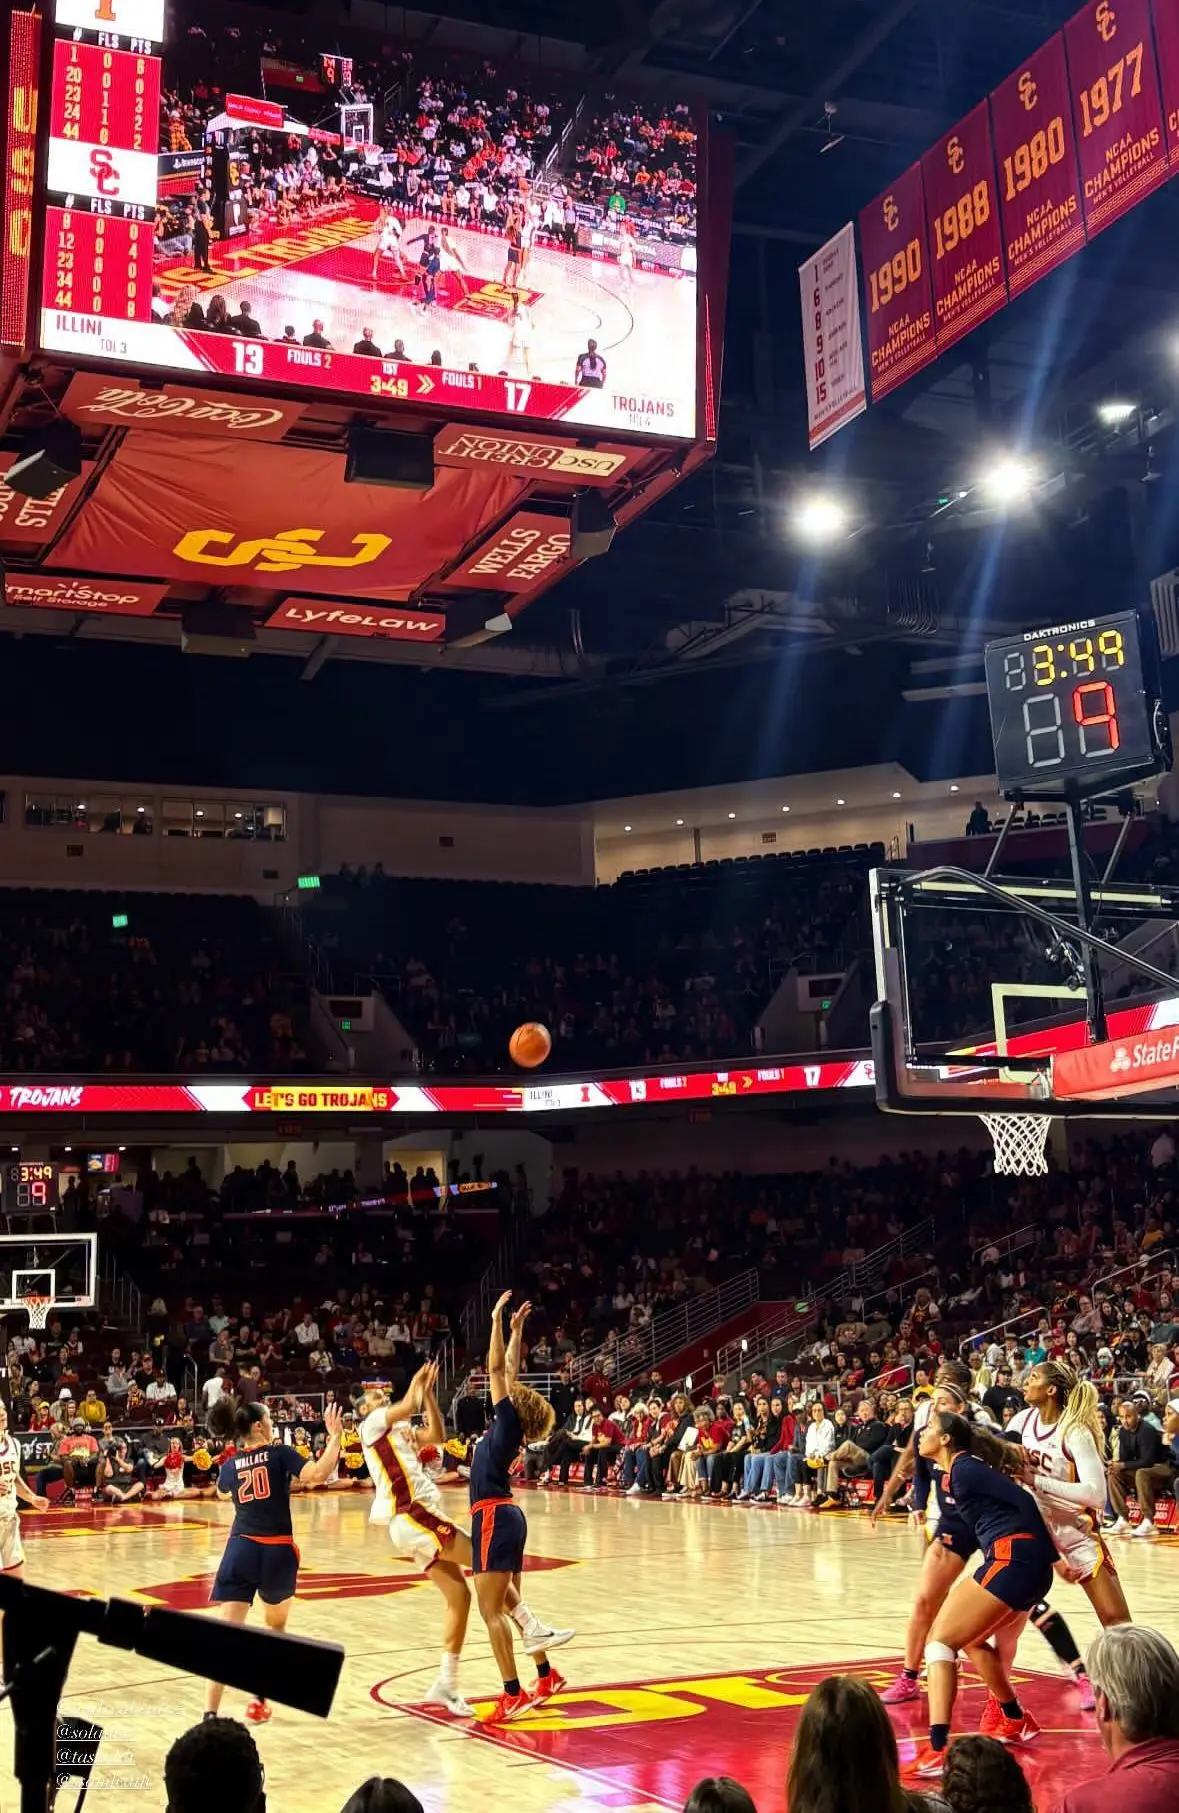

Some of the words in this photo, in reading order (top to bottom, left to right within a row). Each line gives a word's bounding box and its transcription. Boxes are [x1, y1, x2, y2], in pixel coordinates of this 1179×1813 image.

[98, 32, 119, 48] FLS
[130, 38, 152, 55] PTS
[71, 45, 78, 62] 1
[103, 52, 112, 69] 0
[66, 66, 82, 83] 20
[102, 72, 112, 89] 0
[135, 78, 144, 95] 0
[1018, 71, 1037, 111] SC
[1080, 42, 1143, 138] 1977
[65, 84, 81, 102] 23
[102, 90, 109, 107] 1
[64, 102, 80, 121] 24
[101, 108, 108, 125] 1
[134, 115, 142, 131] 2
[62, 121, 79, 139] 44
[133, 134, 141, 150] 2
[1105, 132, 1132, 164] NCAA
[947, 136, 964, 174] SC
[1004, 116, 1065, 201] 1980
[1084, 127, 1160, 198] CHAMPIONS
[89, 149, 120, 196] SC
[1114, 153, 1154, 190] VOLLEYBALL
[91, 198, 112, 214] FLS
[123, 204, 145, 220] PTS
[934, 180, 990, 260] 1988
[1026, 198, 1053, 227] NCAA
[96, 218, 105, 235] 0
[1008, 195, 1077, 260] CHAMPIONS
[58, 231, 74, 249] 12
[57, 251, 74, 269] 23
[128, 262, 137, 279] 0
[869, 238, 922, 313] 1990
[954, 258, 978, 285] NCAA
[56, 271, 73, 288] 34
[93, 276, 101, 293] 0
[936, 256, 1000, 316] CHAMPIONS
[961, 278, 995, 311] VOLLEYBALL
[55, 290, 72, 308] 44
[813, 288, 820, 307] 6
[56, 314, 102, 335] ILLINI
[814, 311, 822, 331] 8
[888, 313, 910, 337] NCAA
[815, 335, 823, 354] 9
[871, 312, 931, 368] CHAMPIONS
[232, 341, 264, 375] 13
[287, 349, 322, 367] FOULS
[324, 354, 332, 369] 2
[814, 359, 825, 383] 10
[370, 375, 408, 397] 3:49
[441, 371, 475, 389] FOULS
[477, 376, 482, 390] 1
[816, 381, 827, 405] 15
[77, 387, 283, 429] Coca-Cola
[504, 381, 532, 412] 17
[612, 395, 675, 418] TROJANS
[438, 443, 549, 469] CREDIT
[455, 436, 559, 460] UNION
[557, 455, 616, 472] USC
[469, 528, 541, 574] WELLS
[507, 533, 571, 580] FARGO
[5, 583, 140, 605] martStop
[1023, 619, 1096, 641] DAKTRONICS
[1033, 630, 1124, 686] 3:49
[1072, 680, 1120, 751] 9
[10, 1086, 83, 1109] TROJANS
[255, 1092, 294, 1107] LET'S
[298, 1092, 317, 1107] GO
[322, 1092, 387, 1107] TROJANS
[21, 1165, 52, 1182] 3:49
[32, 1182, 46, 1205] 9
[235, 1451, 269, 1470] WALLACE
[238, 1466, 270, 1503] 20
